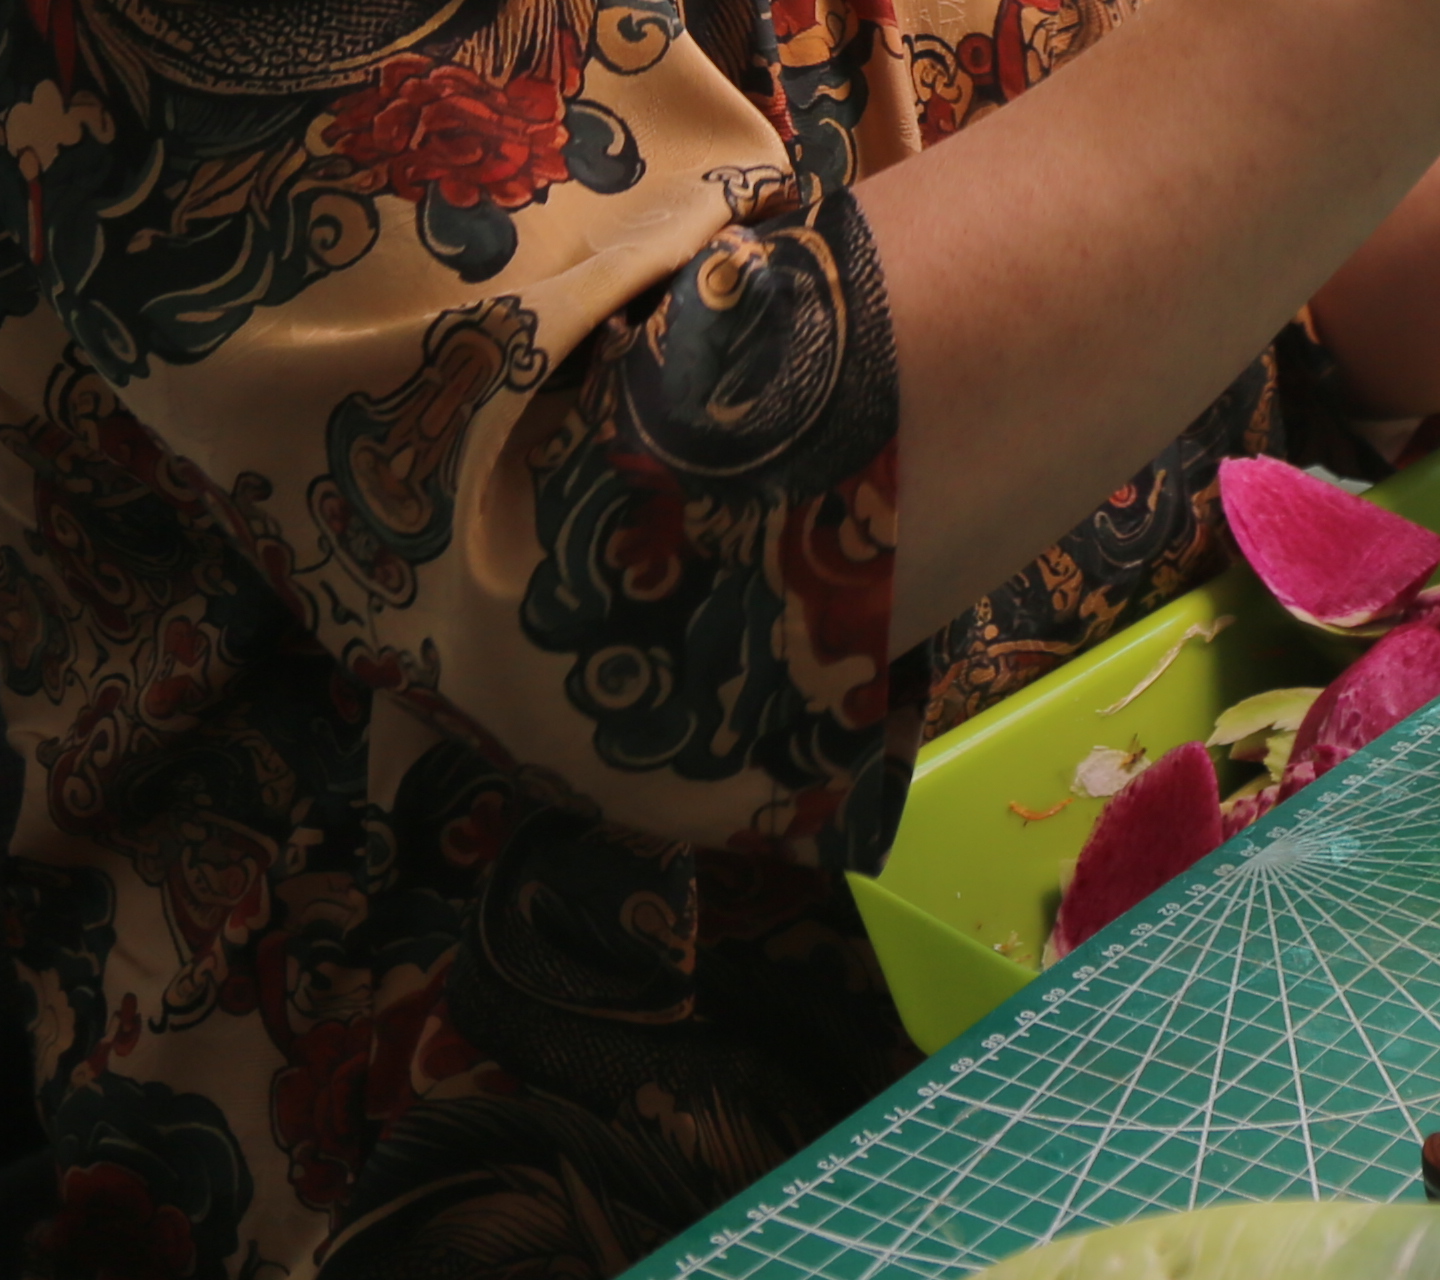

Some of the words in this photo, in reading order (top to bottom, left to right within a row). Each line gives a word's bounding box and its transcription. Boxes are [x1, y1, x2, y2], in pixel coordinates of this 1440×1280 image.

[1185, 884, 1206, 897] 61
[1157, 902, 1181, 916] 62
[1130, 923, 1152, 937] 63
[1101, 944, 1124, 958] 64
[1072, 965, 1096, 980] 65
[1042, 987, 1066, 1003] 66
[1014, 1010, 1036, 1027] 67
[981, 1034, 1005, 1050] 68
[950, 1057, 974, 1073] 69
[917, 1081, 943, 1098] 70
[884, 1106, 908, 1122] 71
[850, 1129, 878, 1147] 72
[817, 1153, 844, 1171] 73
[783, 1177, 809, 1196] 74
[747, 1203, 775, 1221] 75
[710, 1228, 738, 1246] 76
[676, 1253, 702, 1274] 77
